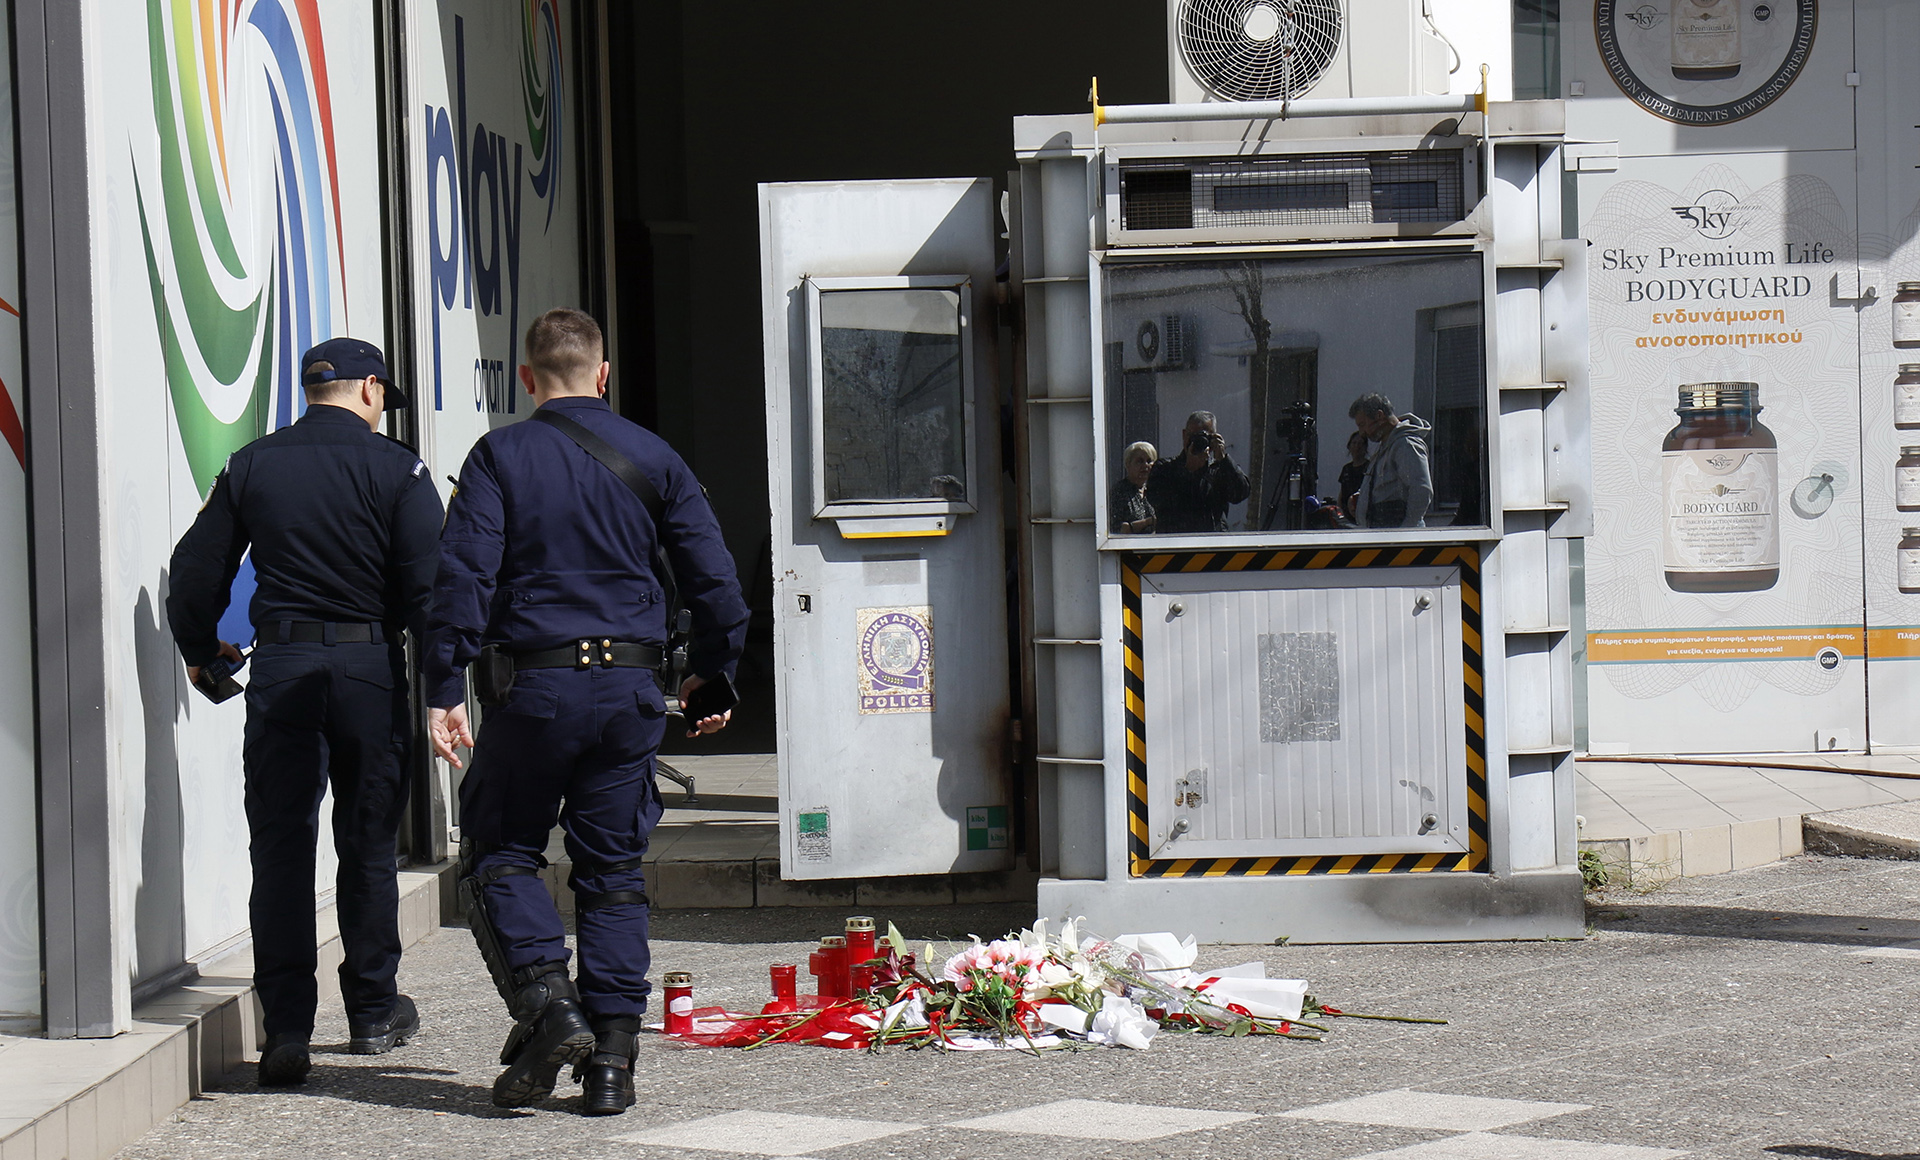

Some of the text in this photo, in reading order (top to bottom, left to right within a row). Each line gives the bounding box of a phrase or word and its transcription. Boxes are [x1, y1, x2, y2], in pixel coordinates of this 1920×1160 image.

[1600, 30, 1640, 94] NUTRITION
[1637, 91, 1728, 121] SUPPLEMENTS
[425, 14, 523, 414] play
[1671, 206, 1732, 236] Sky
[1602, 242, 1834, 275] Sky Premium Life
[1625, 276, 1812, 302] BODYGUARD
[1652, 308, 1785, 325] ενδυνάμωση
[1635, 328, 1803, 348] ανοσοποιητικού
[1683, 502, 1759, 514] BODYGUARD
[862, 615, 930, 676] ΕΛΛΗΝΙΚΗ ΑΣΤΥΝΟΜΙΑ
[1595, 638, 1622, 646] Πλήρης
[1644, 636, 1705, 645] συμπληρωμάτων
[1705, 647, 1736, 655] ενέργεια
[1750, 646, 1784, 654] ομορφιά!
[1821, 656, 1838, 664] GMP
[863, 695, 932, 708] POLICE
